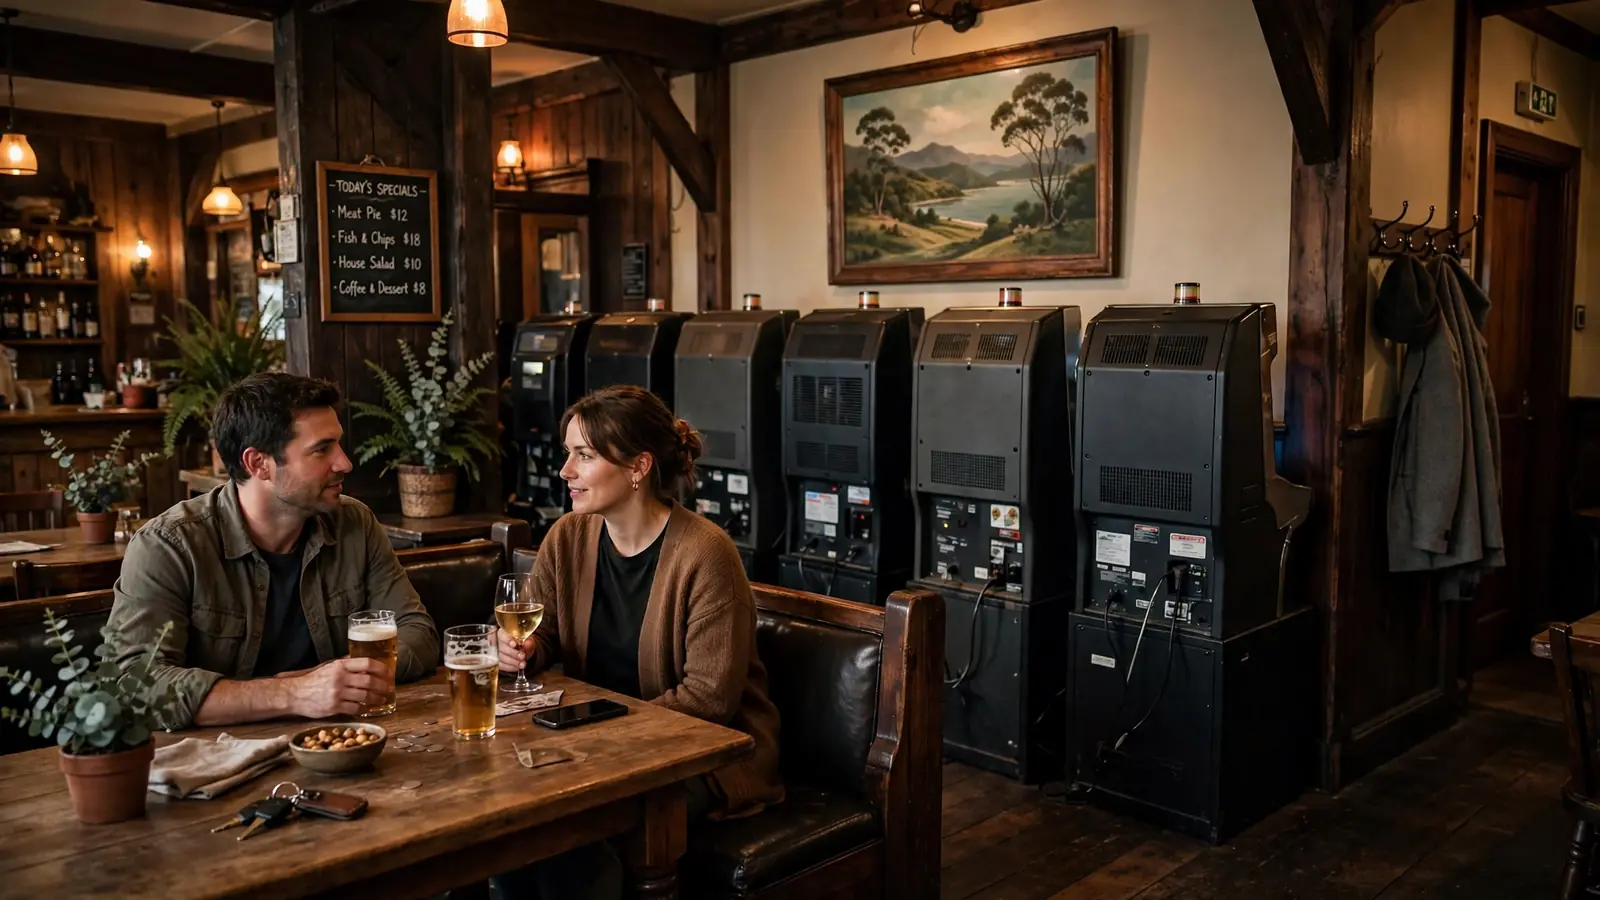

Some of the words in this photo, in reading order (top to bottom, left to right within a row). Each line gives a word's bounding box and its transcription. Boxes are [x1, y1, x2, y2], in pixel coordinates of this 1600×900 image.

[377, 183, 418, 197] SPECIALS
[337, 205, 362, 219] Meat
[366, 206, 382, 220] Pie
[390, 208, 408, 221] $12
[338, 230, 357, 244] Fish
[361, 232, 368, 244] &
[371, 231, 396, 249] Chips
[403, 232, 421, 246] $18
[338, 255, 366, 269] House
[370, 255, 395, 269] Salad
[404, 257, 422, 270] $10
[338, 280, 366, 297] Coffee
[369, 282, 375, 294] &
[378, 280, 409, 294] Dessert
[413, 282, 426, 295] $8
